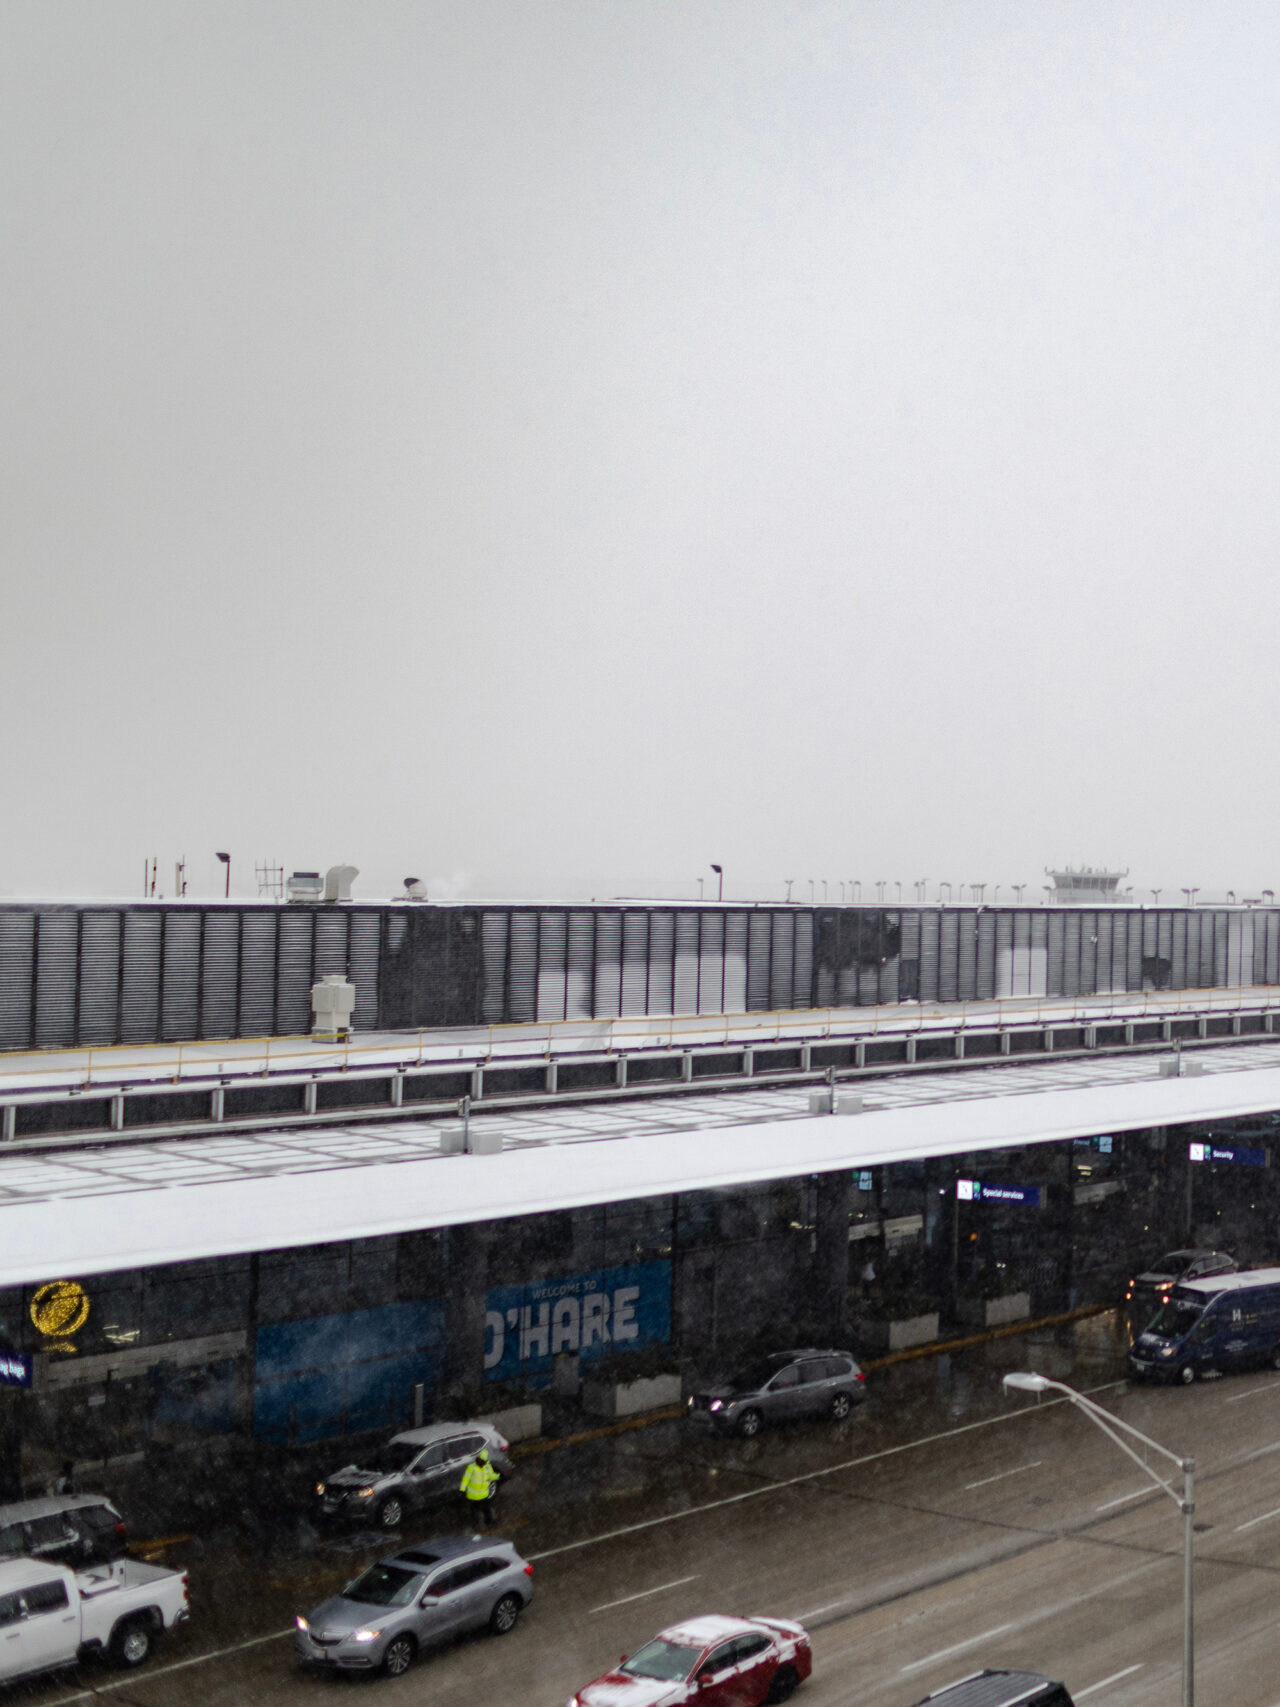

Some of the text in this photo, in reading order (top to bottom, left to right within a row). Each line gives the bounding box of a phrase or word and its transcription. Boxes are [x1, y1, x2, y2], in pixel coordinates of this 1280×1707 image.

[1213, 1150, 1234, 1160] Security
[983, 1188, 1024, 1199] Special services
[533, 1279, 597, 1299] WELCOME TO
[484, 1286, 640, 1369] O'HARE
